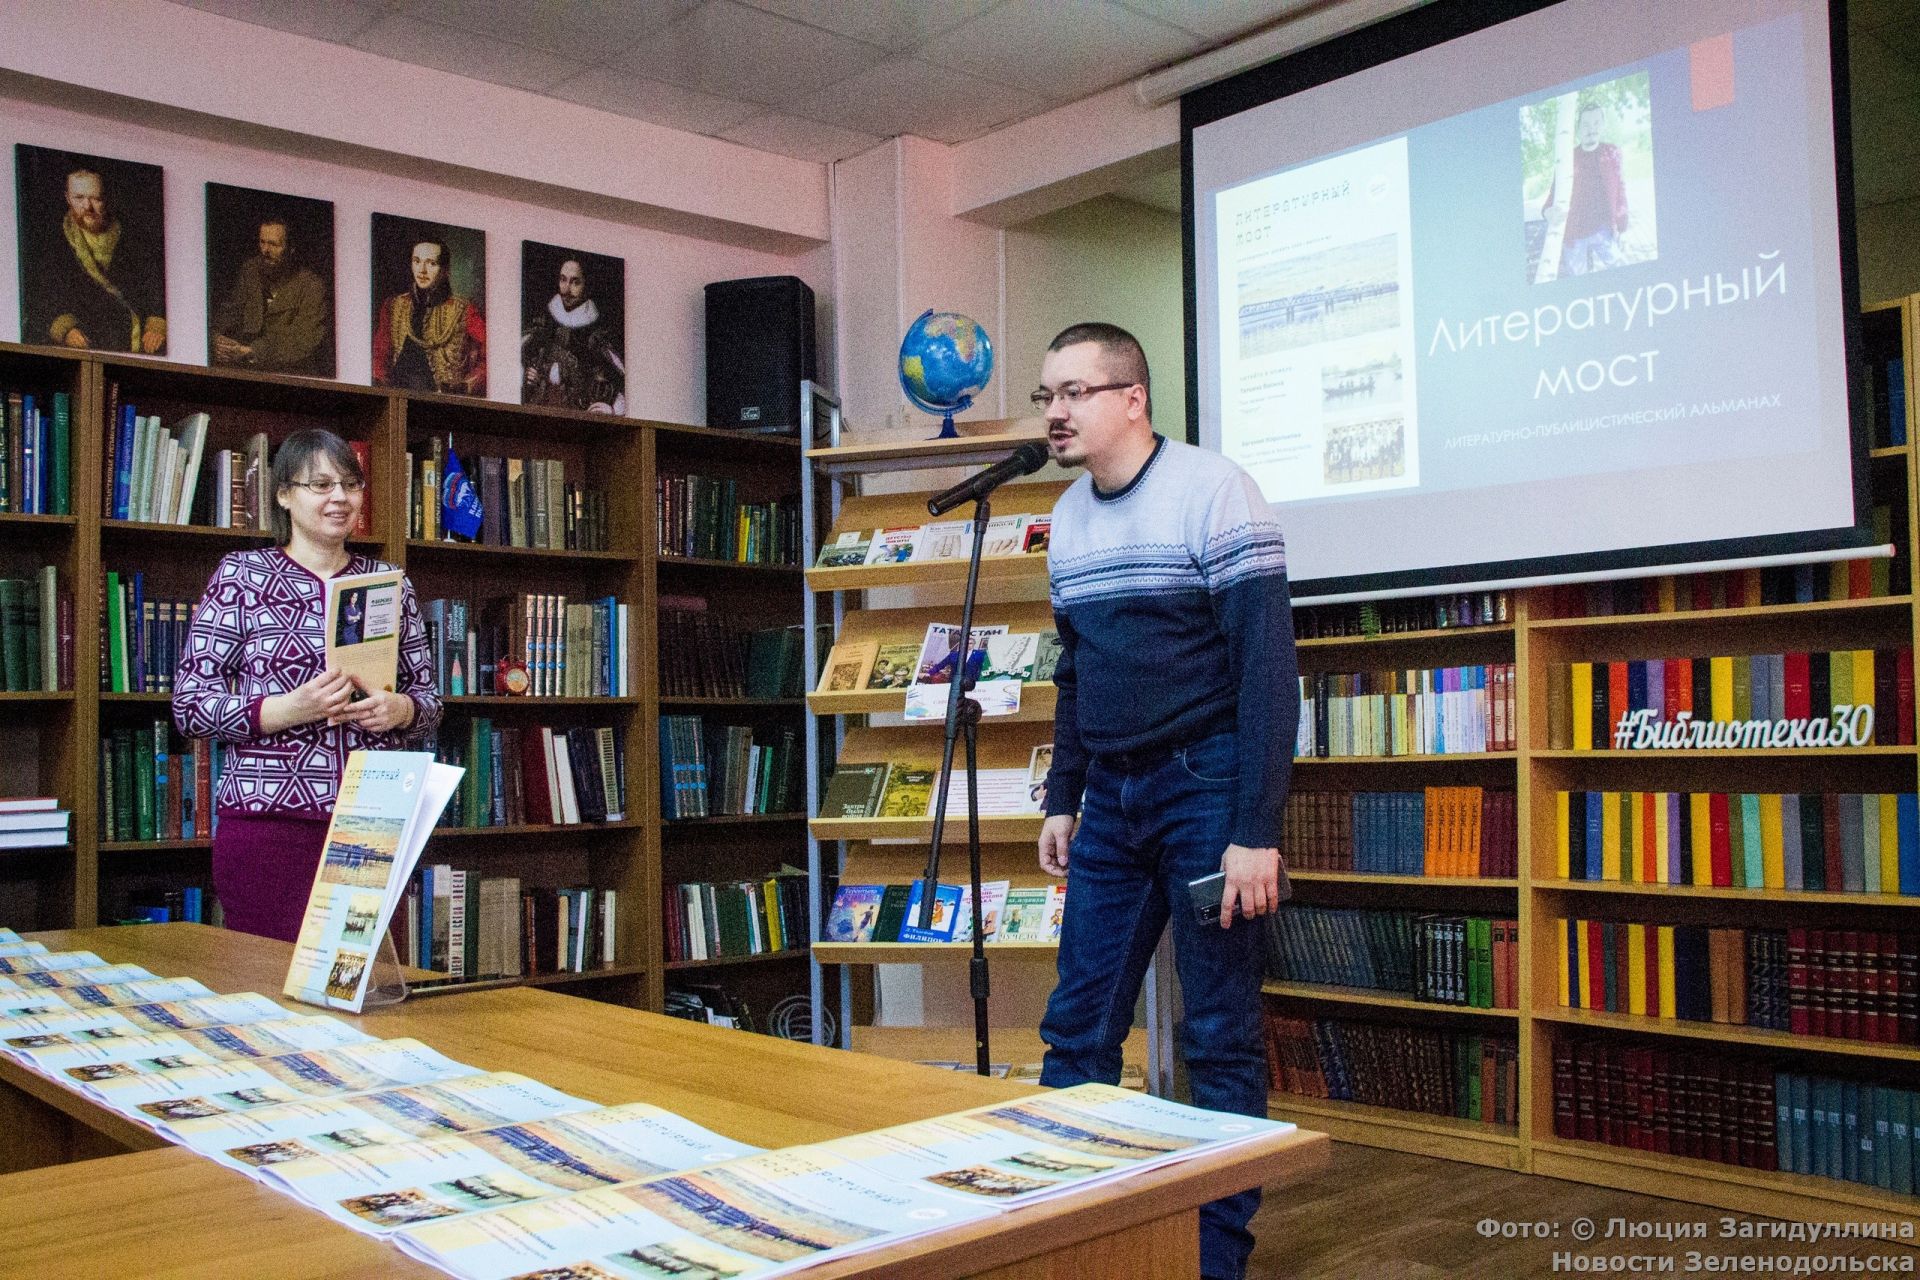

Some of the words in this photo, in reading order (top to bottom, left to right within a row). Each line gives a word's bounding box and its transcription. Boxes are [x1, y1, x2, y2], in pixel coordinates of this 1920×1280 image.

[1428, 249, 1786, 357] Литературный
[1443, 402, 1686, 450] ЛИТЕРАТУРНО-ПУБЛИЦИСТИЧЕСКИЙ
[1689, 393, 1782, 418] АЛЬМАНАХ
[932, 626, 1003, 637] ТАТАСТАН
[1614, 703, 1876, 750] #Библиотека30
